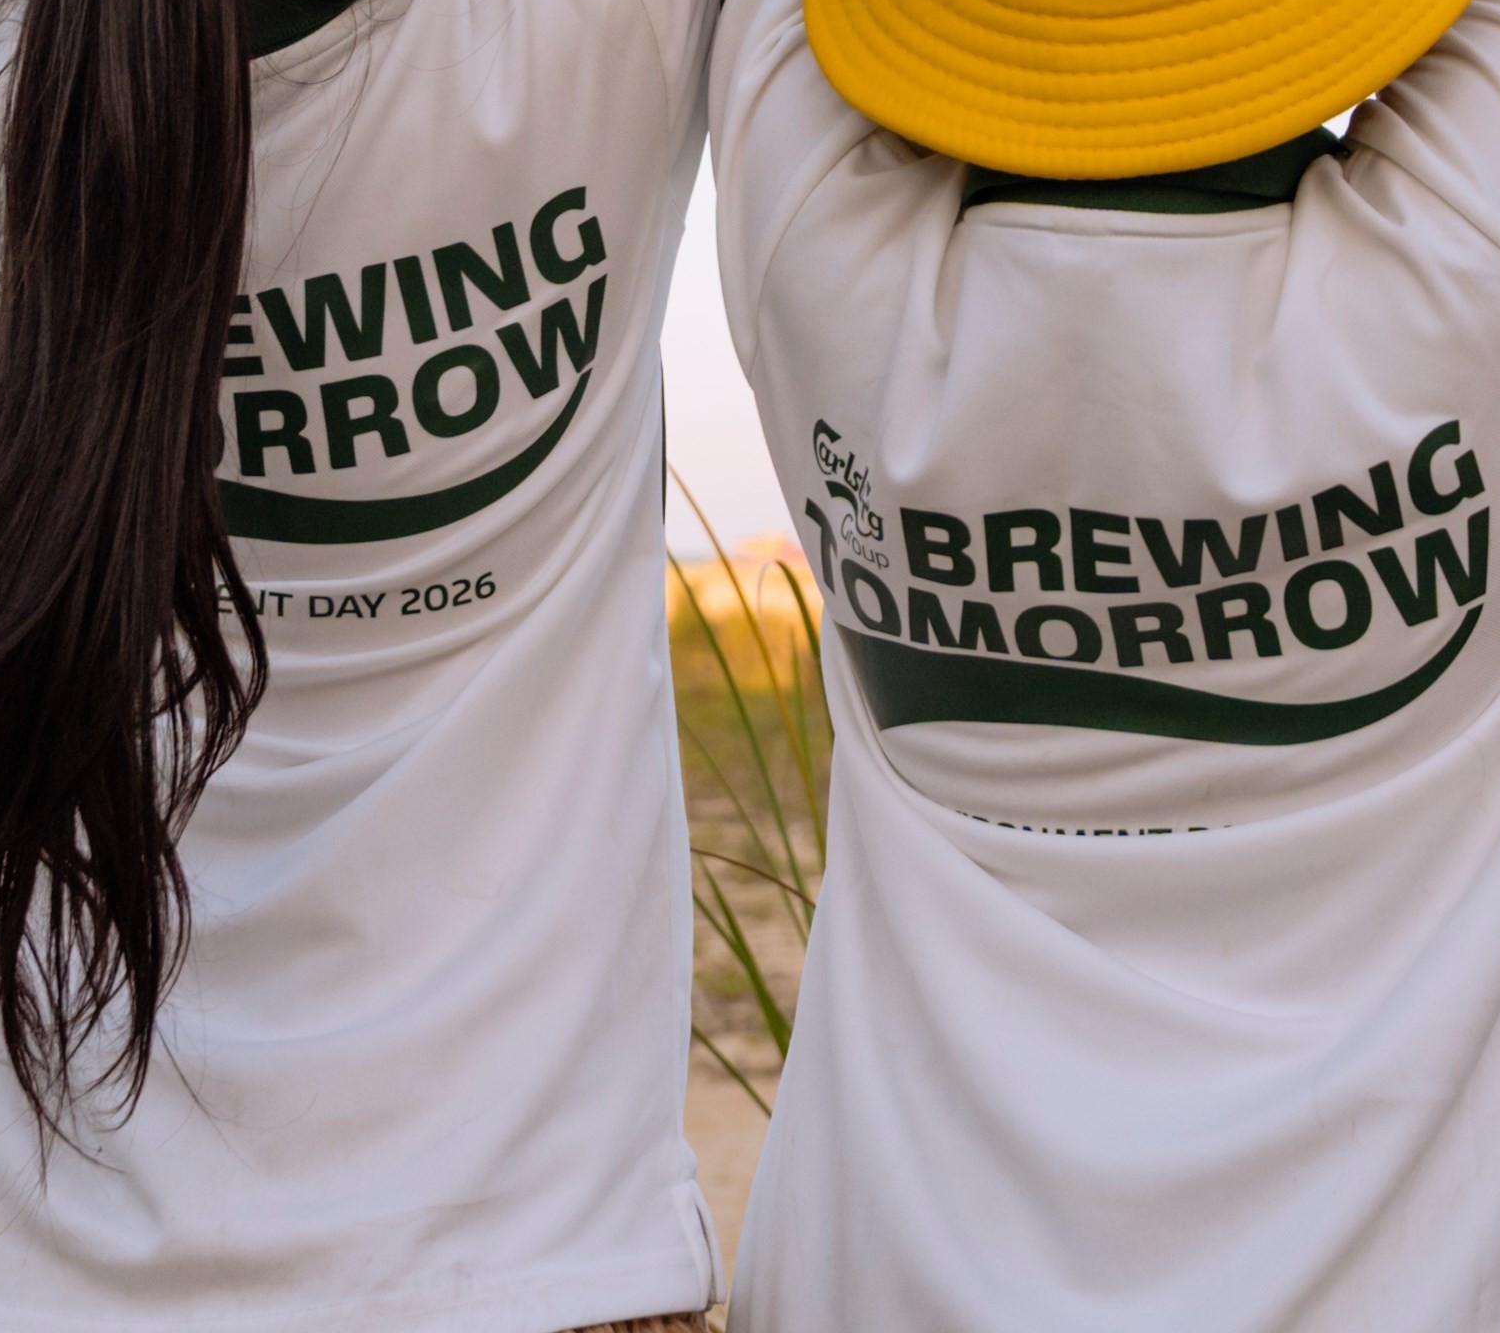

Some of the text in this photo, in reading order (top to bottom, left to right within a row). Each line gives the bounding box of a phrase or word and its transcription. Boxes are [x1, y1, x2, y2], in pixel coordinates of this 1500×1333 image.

[221, 186, 607, 377] EWING
[804, 497, 1491, 668] TOMORROW
[900, 419, 1486, 594] BREWING
[308, 592, 387, 620] DAY
[401, 571, 497, 616] 2026
